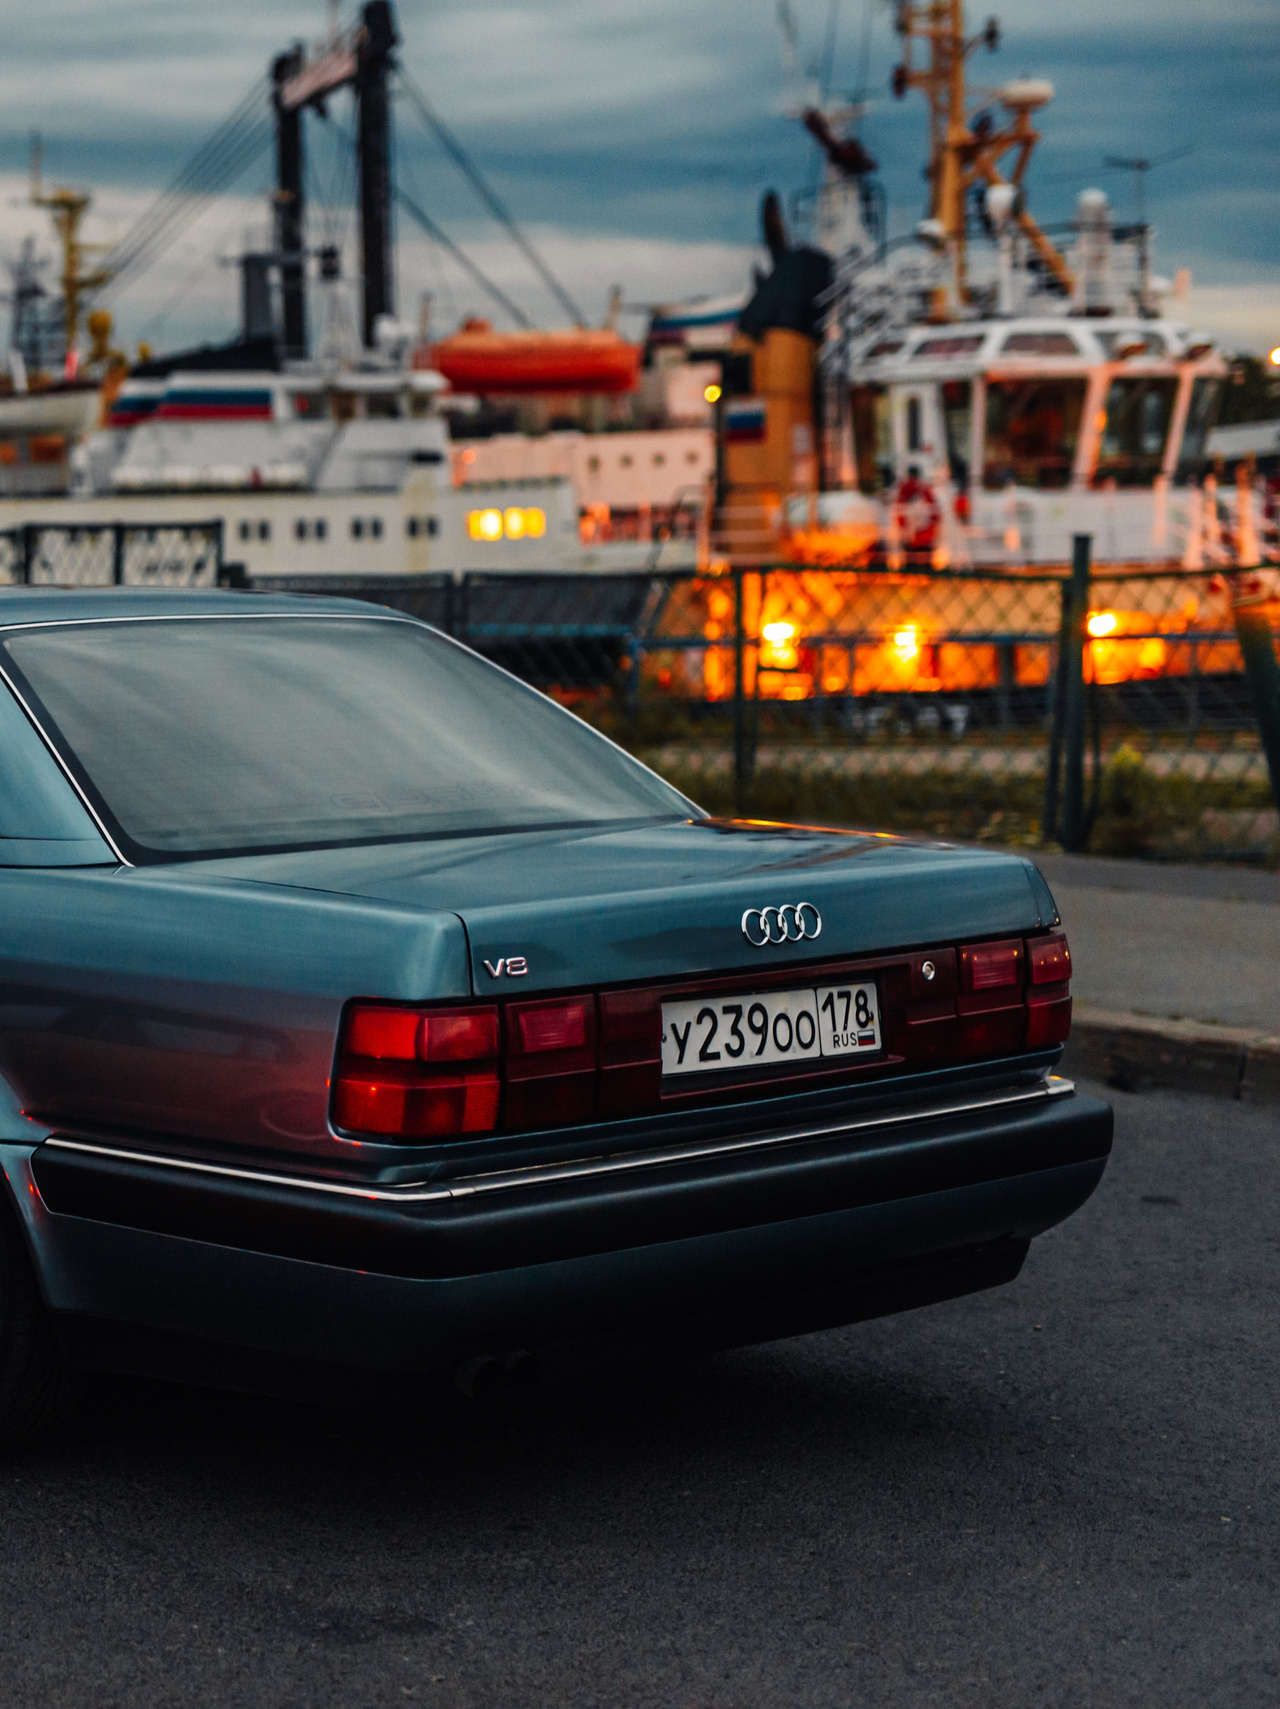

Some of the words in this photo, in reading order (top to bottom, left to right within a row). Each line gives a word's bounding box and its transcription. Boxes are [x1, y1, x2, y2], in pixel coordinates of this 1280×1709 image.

[482, 956, 529, 979] V8
[821, 989, 871, 1033] 178
[833, 1032, 857, 1049] RUS
